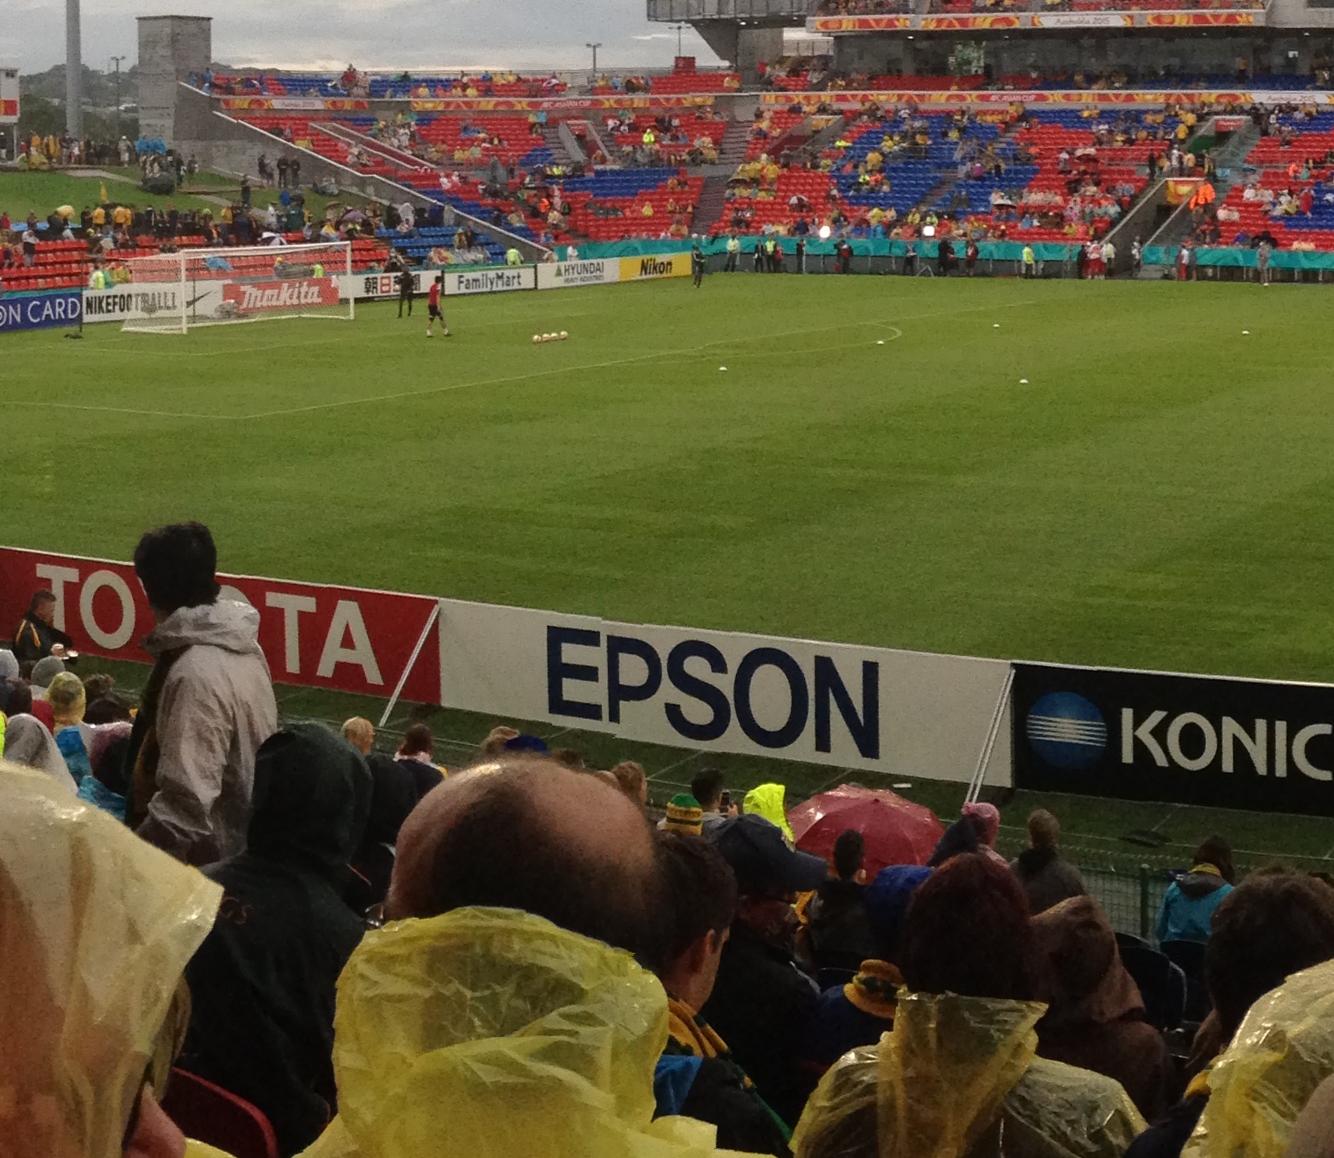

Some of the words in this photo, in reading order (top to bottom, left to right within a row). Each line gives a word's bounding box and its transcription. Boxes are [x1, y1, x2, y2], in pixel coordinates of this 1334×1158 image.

[564, 262, 604, 276] HYUNDAI
[640, 258, 673, 276] Nikon
[457, 271, 521, 292] FamilyMart
[27, 298, 81, 323] CARD
[36, 563, 385, 686] TOTA
[547, 625, 880, 760] EPSON
